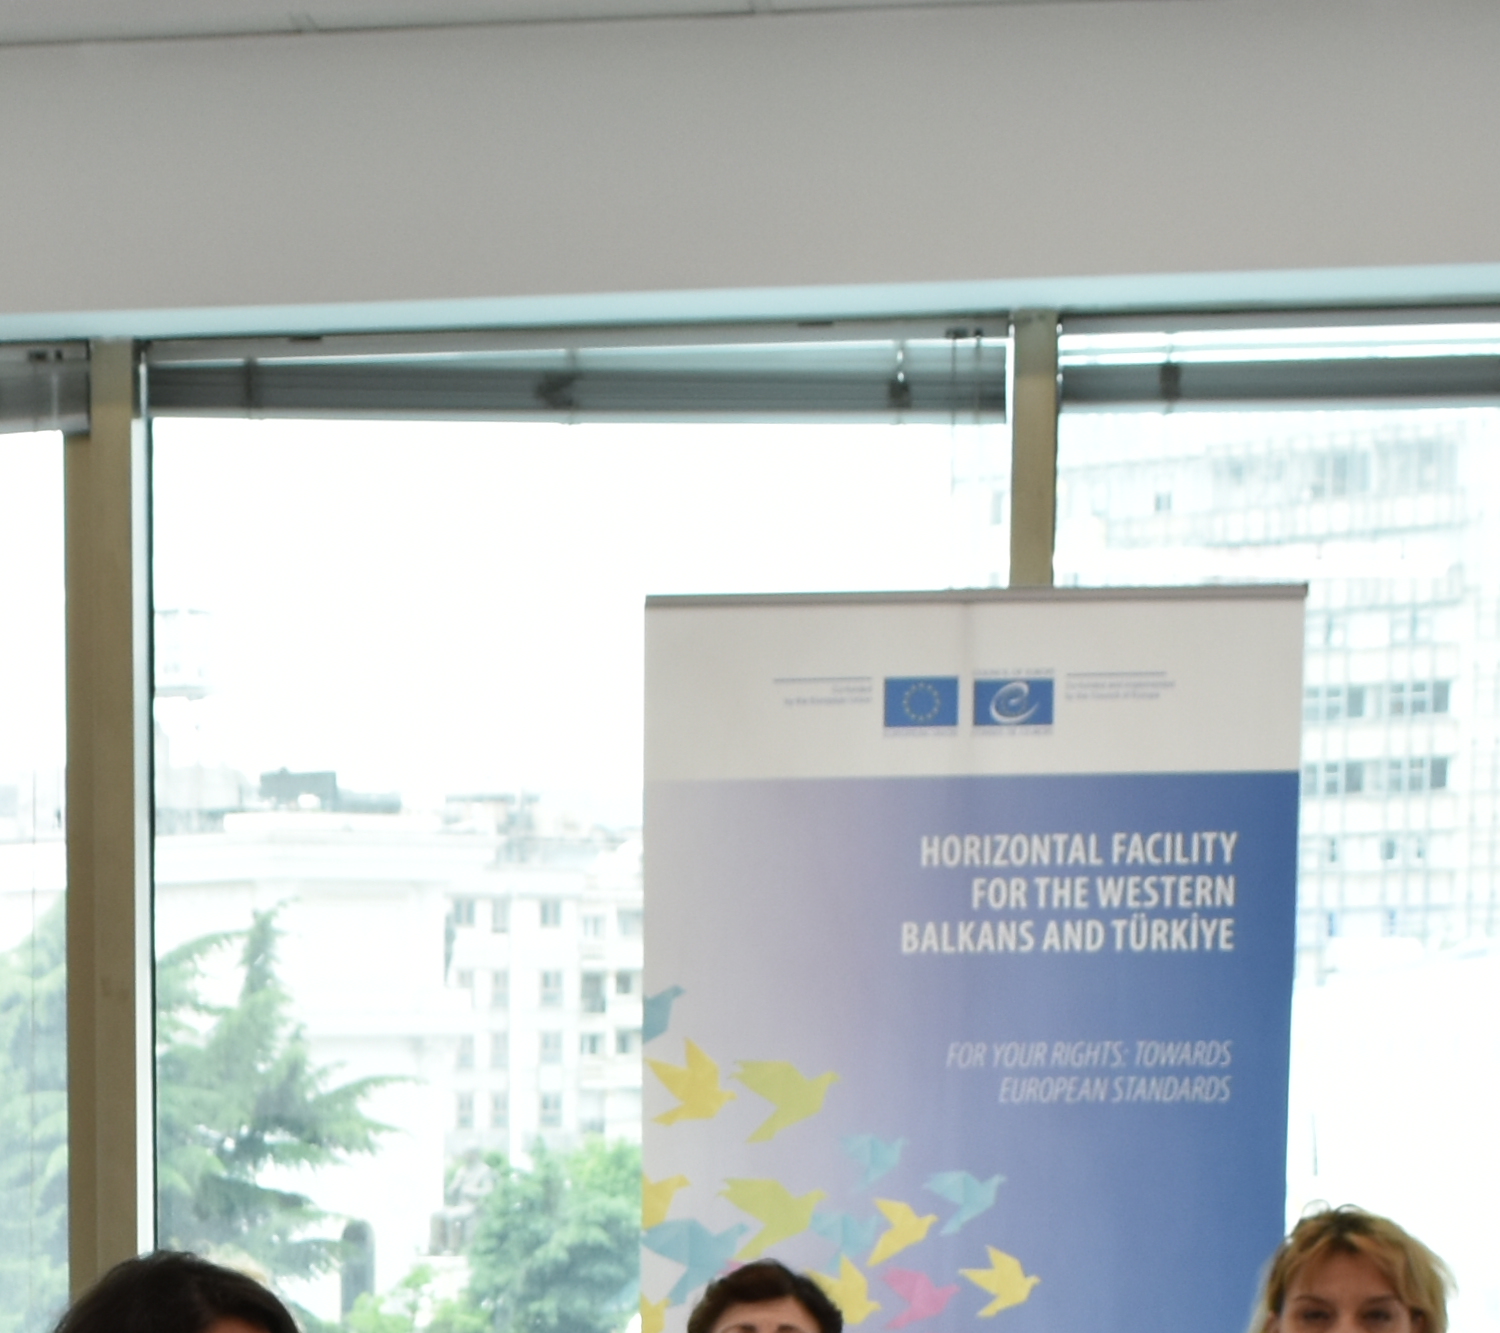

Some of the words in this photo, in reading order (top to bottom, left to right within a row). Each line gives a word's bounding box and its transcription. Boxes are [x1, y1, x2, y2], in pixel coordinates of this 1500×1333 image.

[920, 833, 1103, 867] HORIZONTAL
[1111, 831, 1238, 865] FACILITY
[972, 877, 1028, 910] FOR
[1034, 876, 1089, 909] THE
[1097, 875, 1235, 908] WESTERN
[901, 920, 1034, 953] BALKANS
[1042, 919, 1105, 952] AND
[946, 1041, 986, 1068] FOR
[993, 1041, 1048, 1068] YOUR
[1135, 1039, 1233, 1068] TOWARDS
[1000, 1075, 1110, 1104] EUROPEAN
[1114, 1074, 1232, 1103] STANDARDS
